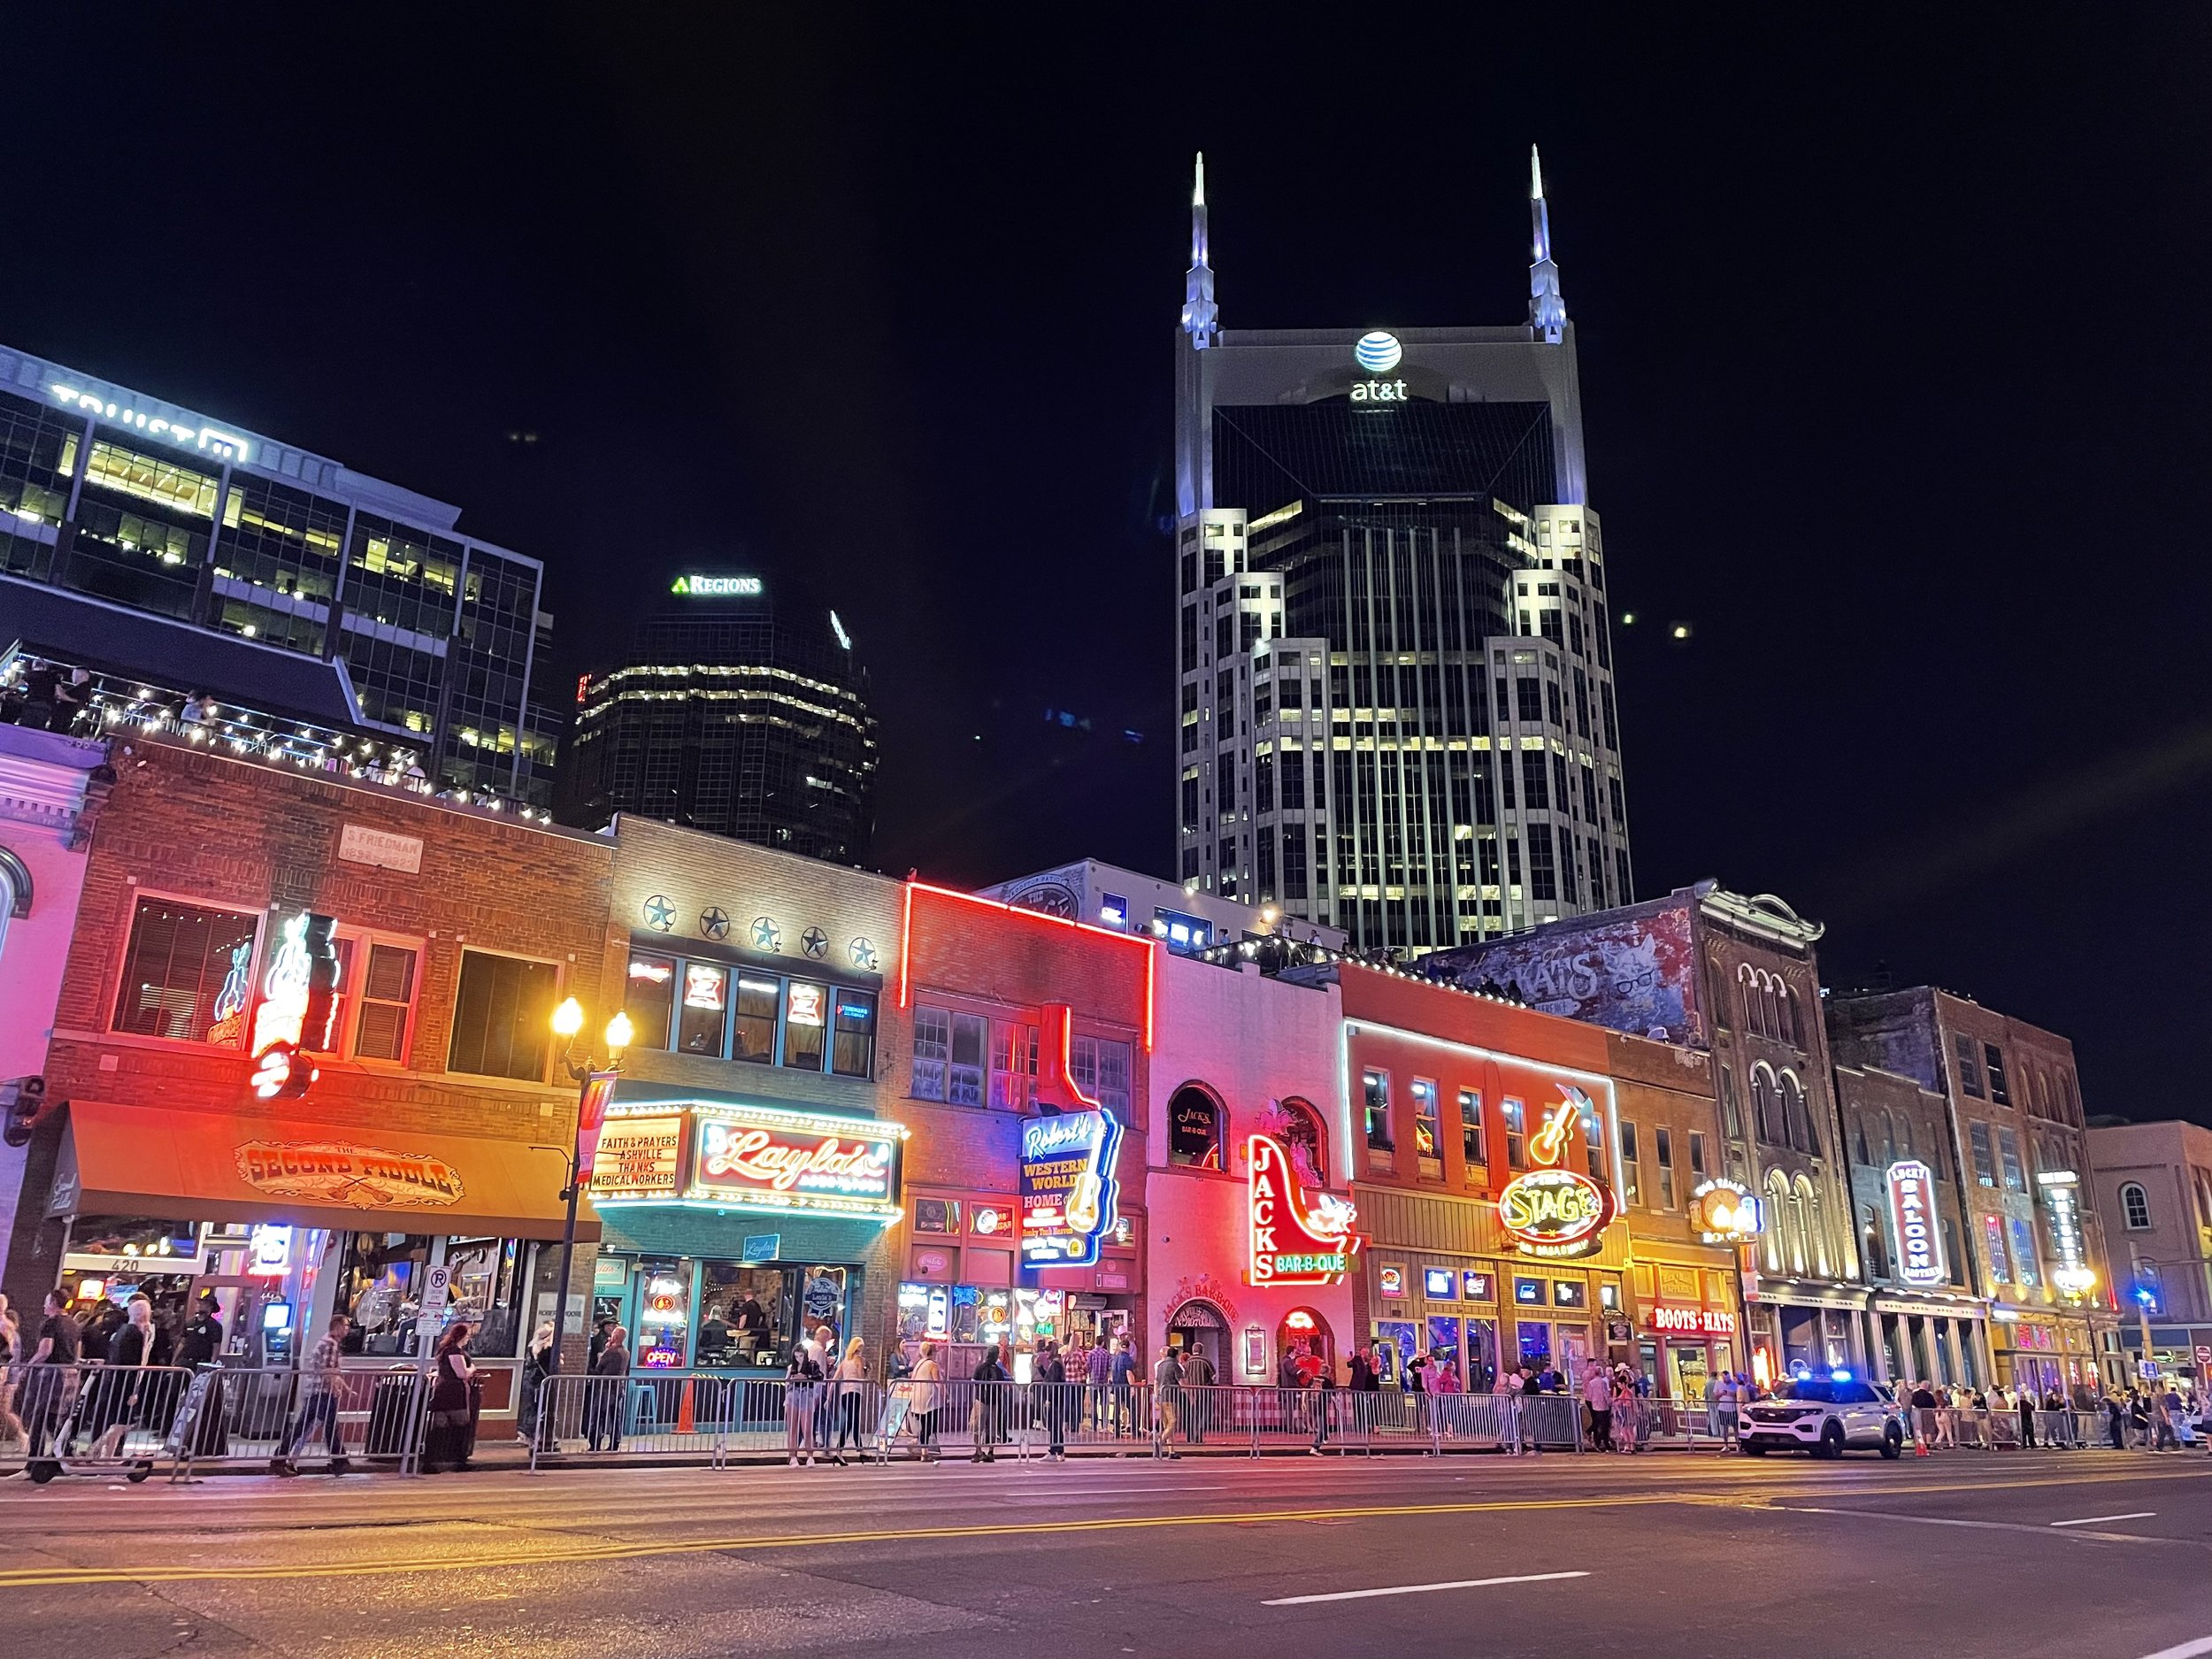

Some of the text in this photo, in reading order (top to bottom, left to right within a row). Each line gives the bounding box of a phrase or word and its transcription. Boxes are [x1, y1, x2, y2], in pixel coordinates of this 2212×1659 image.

[1351, 379, 1408, 401] at&t
[357, 833, 419, 855] FRIEDMAN
[602, 1136, 677, 1148] FAITH & PRAYERS
[1026, 1115, 1091, 1162] Robert's
[618, 1162, 655, 1173] THANKS
[708, 1130, 885, 1190] Layla's
[1024, 1158, 1088, 1178] WESTERN
[247, 1148, 456, 1197] SECOND FIDDLE
[1891, 1168, 1926, 1182] LUCKY
[1032, 1174, 1078, 1191] WORLD
[1024, 1194, 1062, 1209] HOME
[1505, 1183, 1599, 1230] STAGE
[1254, 1148, 1279, 1279] JACKS
[1900, 1179, 1930, 1268] SALOON
[746, 1241, 776, 1257] Layla's
[111, 1260, 139, 1272] 420
[1275, 1254, 1346, 1272] BAR-B-QUE
[1035, 1323, 1055, 1335] ATM
[1655, 1308, 1735, 1333] BOOTS HATS
[647, 1351, 676, 1364] OPEN
